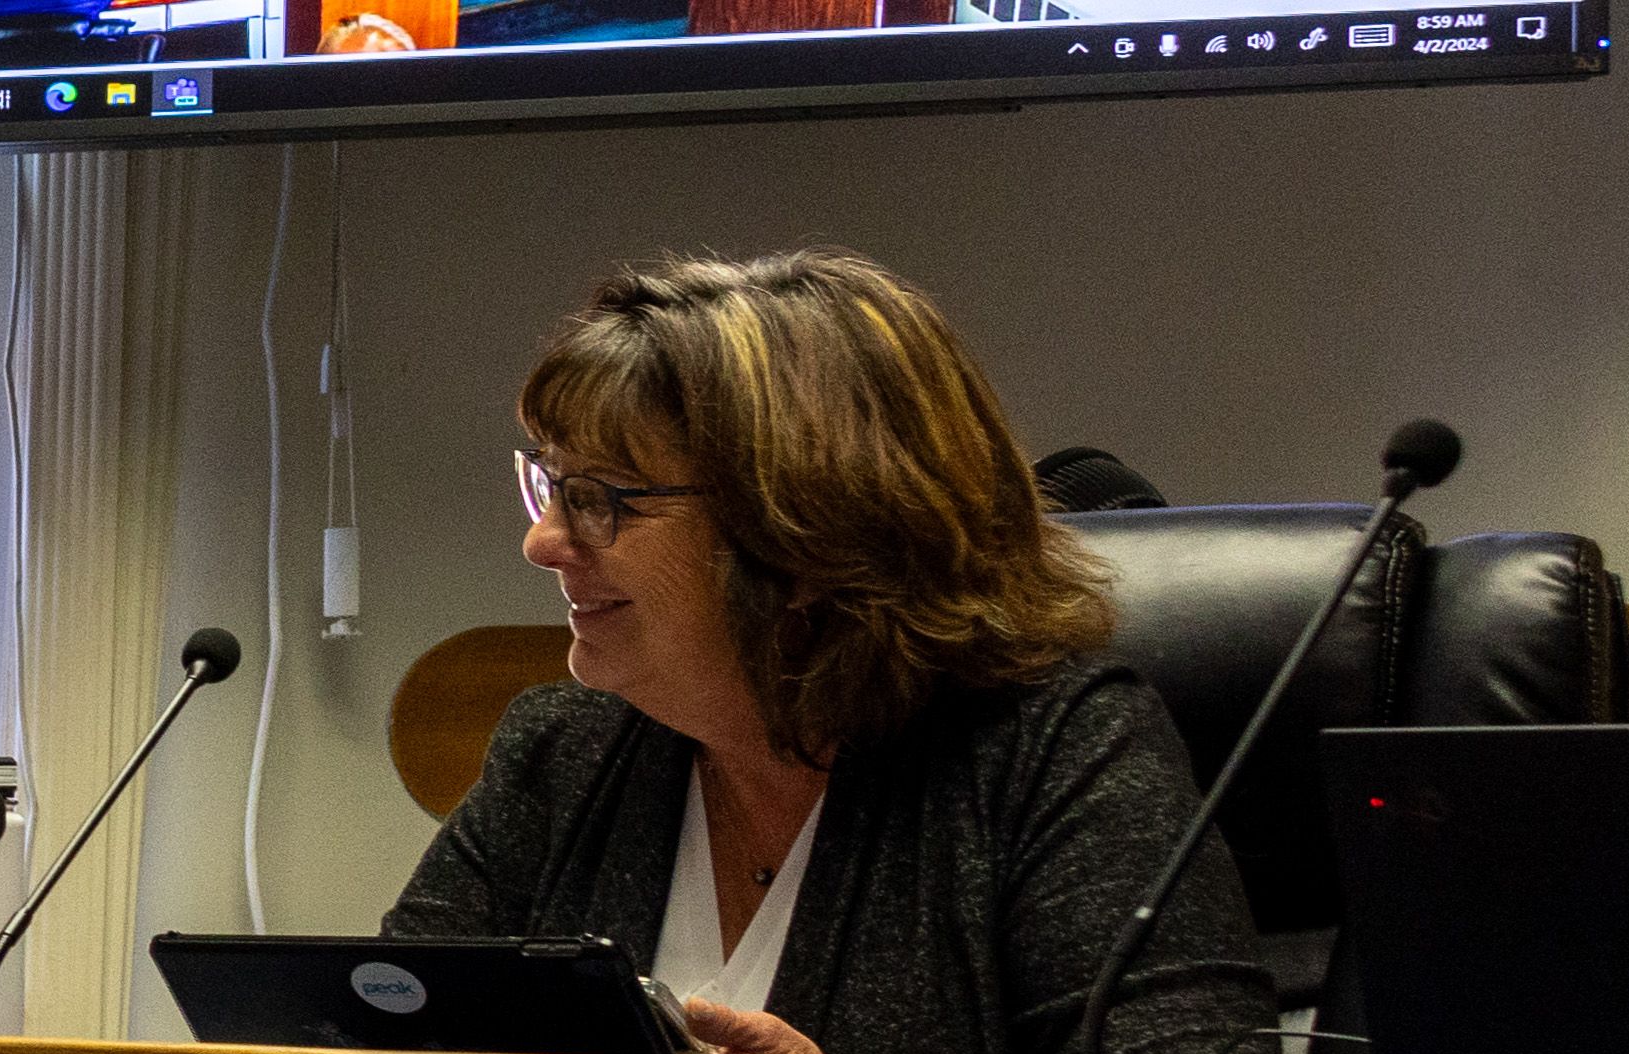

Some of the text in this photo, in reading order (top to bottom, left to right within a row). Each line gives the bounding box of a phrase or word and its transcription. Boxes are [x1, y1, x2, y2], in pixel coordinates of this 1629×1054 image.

[1416, 14, 1485, 30] 8:59 AM
[1413, 37, 1490, 53] 4/2/2024
